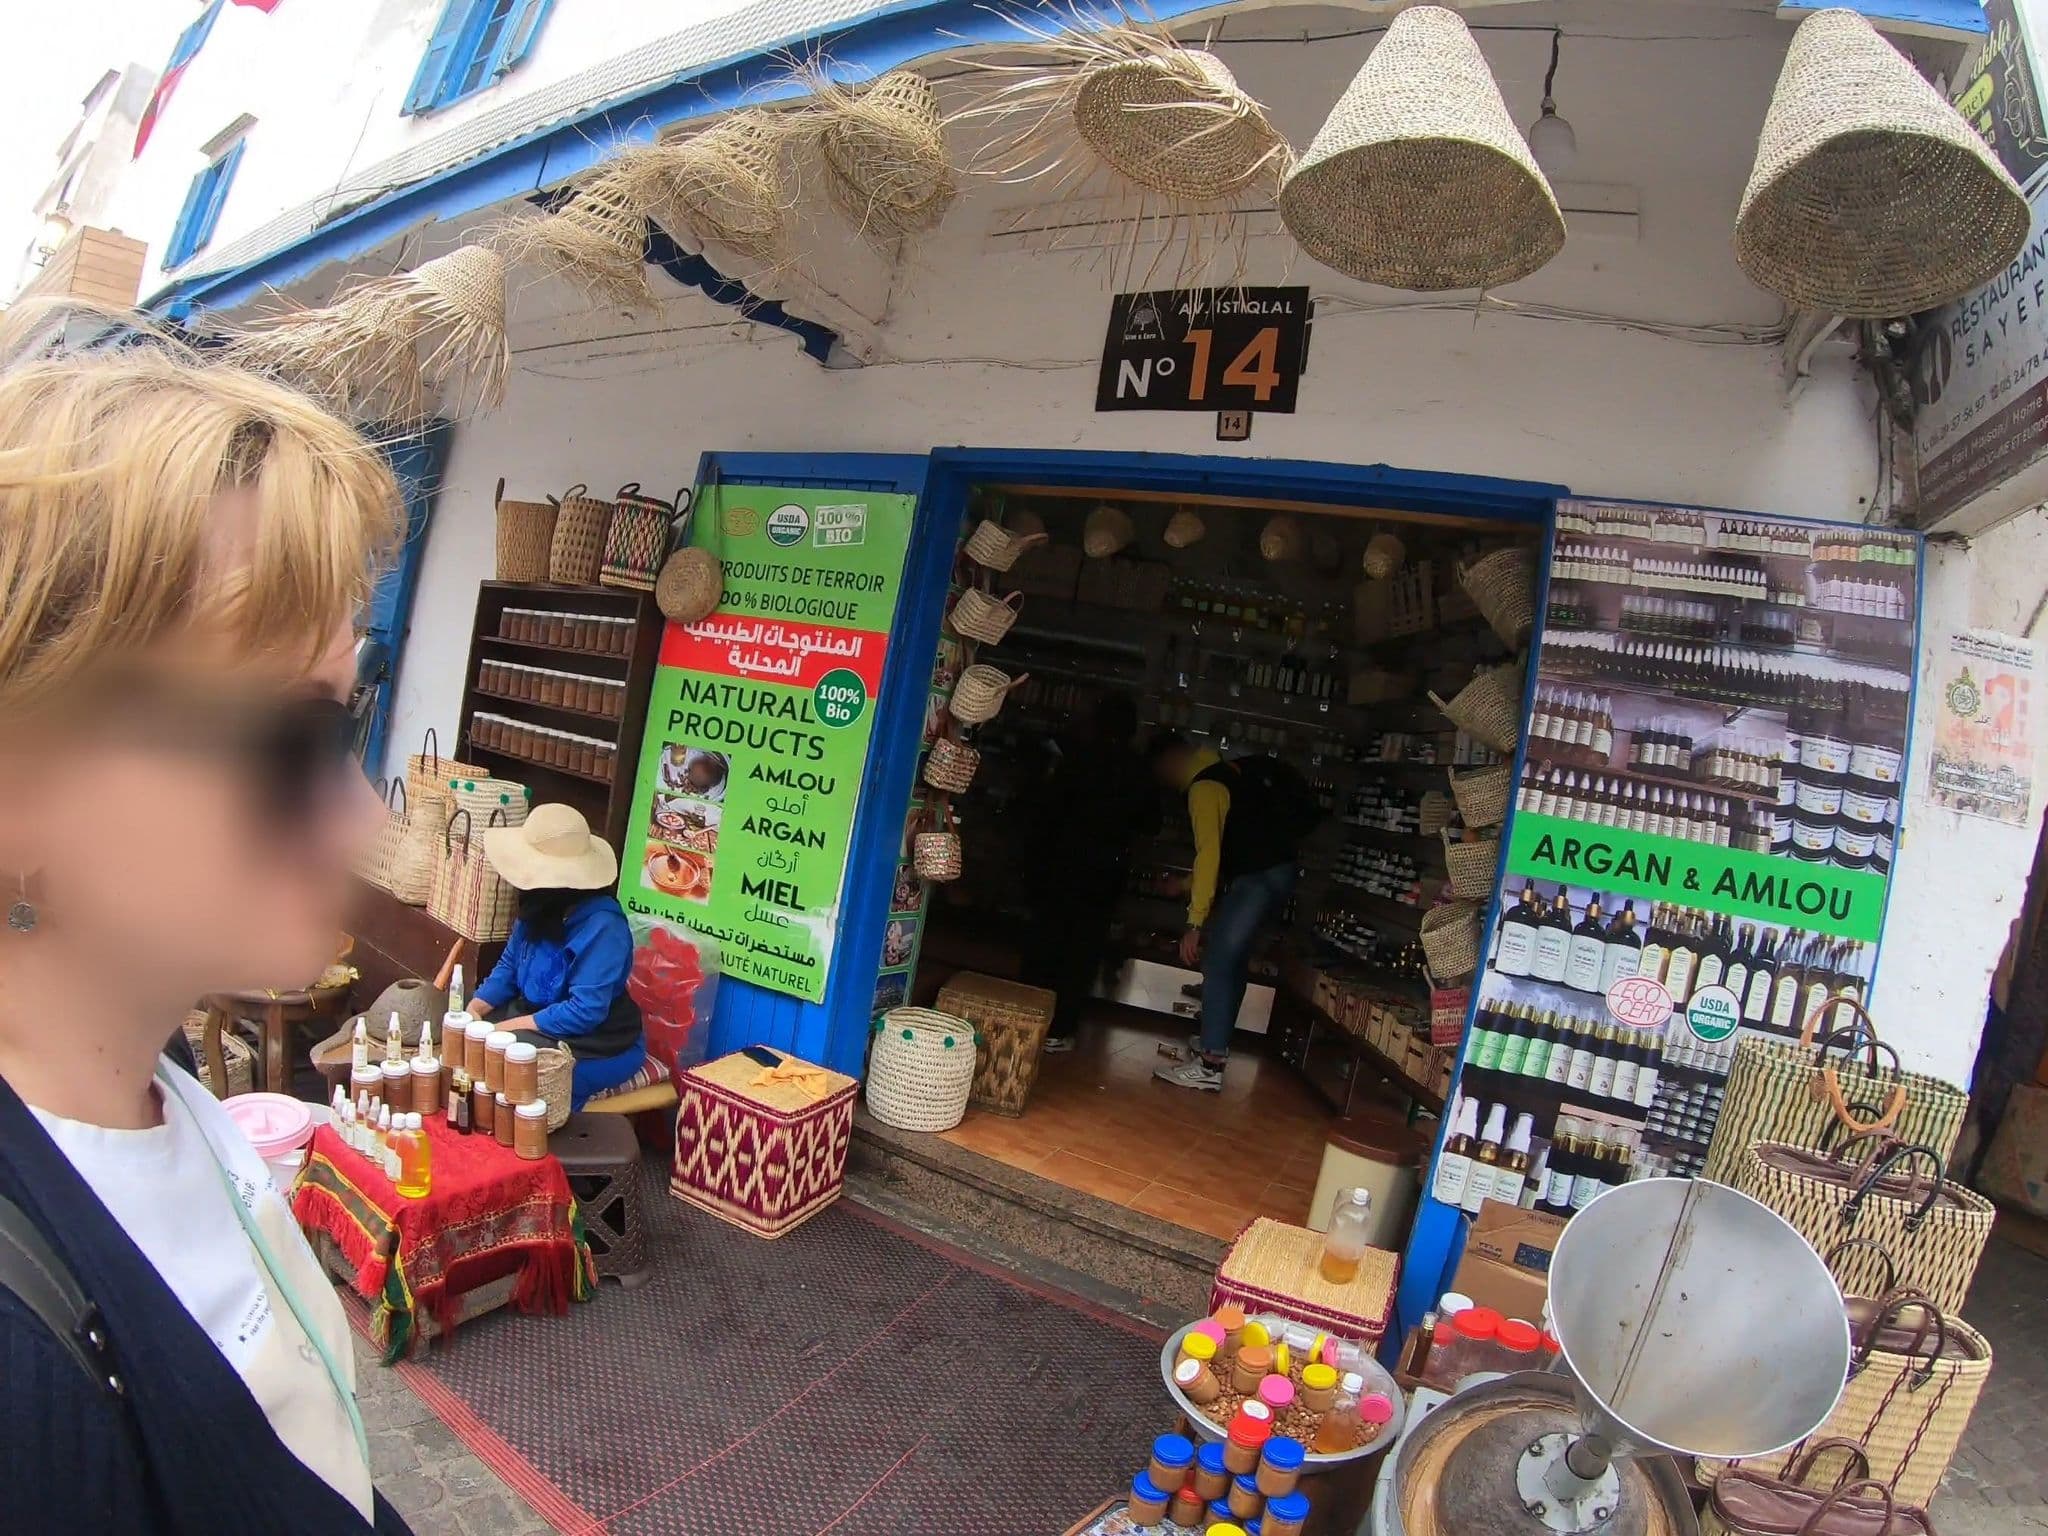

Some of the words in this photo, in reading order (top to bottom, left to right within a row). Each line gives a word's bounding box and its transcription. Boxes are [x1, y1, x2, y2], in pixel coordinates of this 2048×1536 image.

[1182, 327, 1280, 400] 14
[1223, 417, 1241, 430] 14
[777, 513, 801, 524] USDA
[825, 529, 853, 543] BIO
[792, 567, 817, 586] DE
[816, 569, 885, 593] TERROIR
[719, 591, 741, 608] 00
[760, 593, 859, 621] BIOLOGIQUE
[764, 626, 863, 658] المنتوجات
[727, 645, 803, 678] المحلية
[680, 679, 816, 724] NATURAL
[819, 684, 860, 706] 100%
[825, 702, 850, 720] Bio
[668, 709, 826, 761] PRODUCTS
[749, 763, 836, 795] AMLOU
[765, 795, 810, 816] أملو
[741, 815, 826, 850] ARGAN
[741, 872, 806, 911] MIEL
[1531, 833, 1673, 887] ARGAN
[1682, 867, 1701, 891] &
[1711, 867, 1853, 921] AMLOU
[743, 903, 790, 929] عسل
[735, 928, 816, 968] مستحضرات
[752, 957, 812, 993] NATUREL
[1620, 981, 1662, 1002] ECO
[1700, 995, 1730, 1014] USDA
[1616, 997, 1664, 1022] CERT
